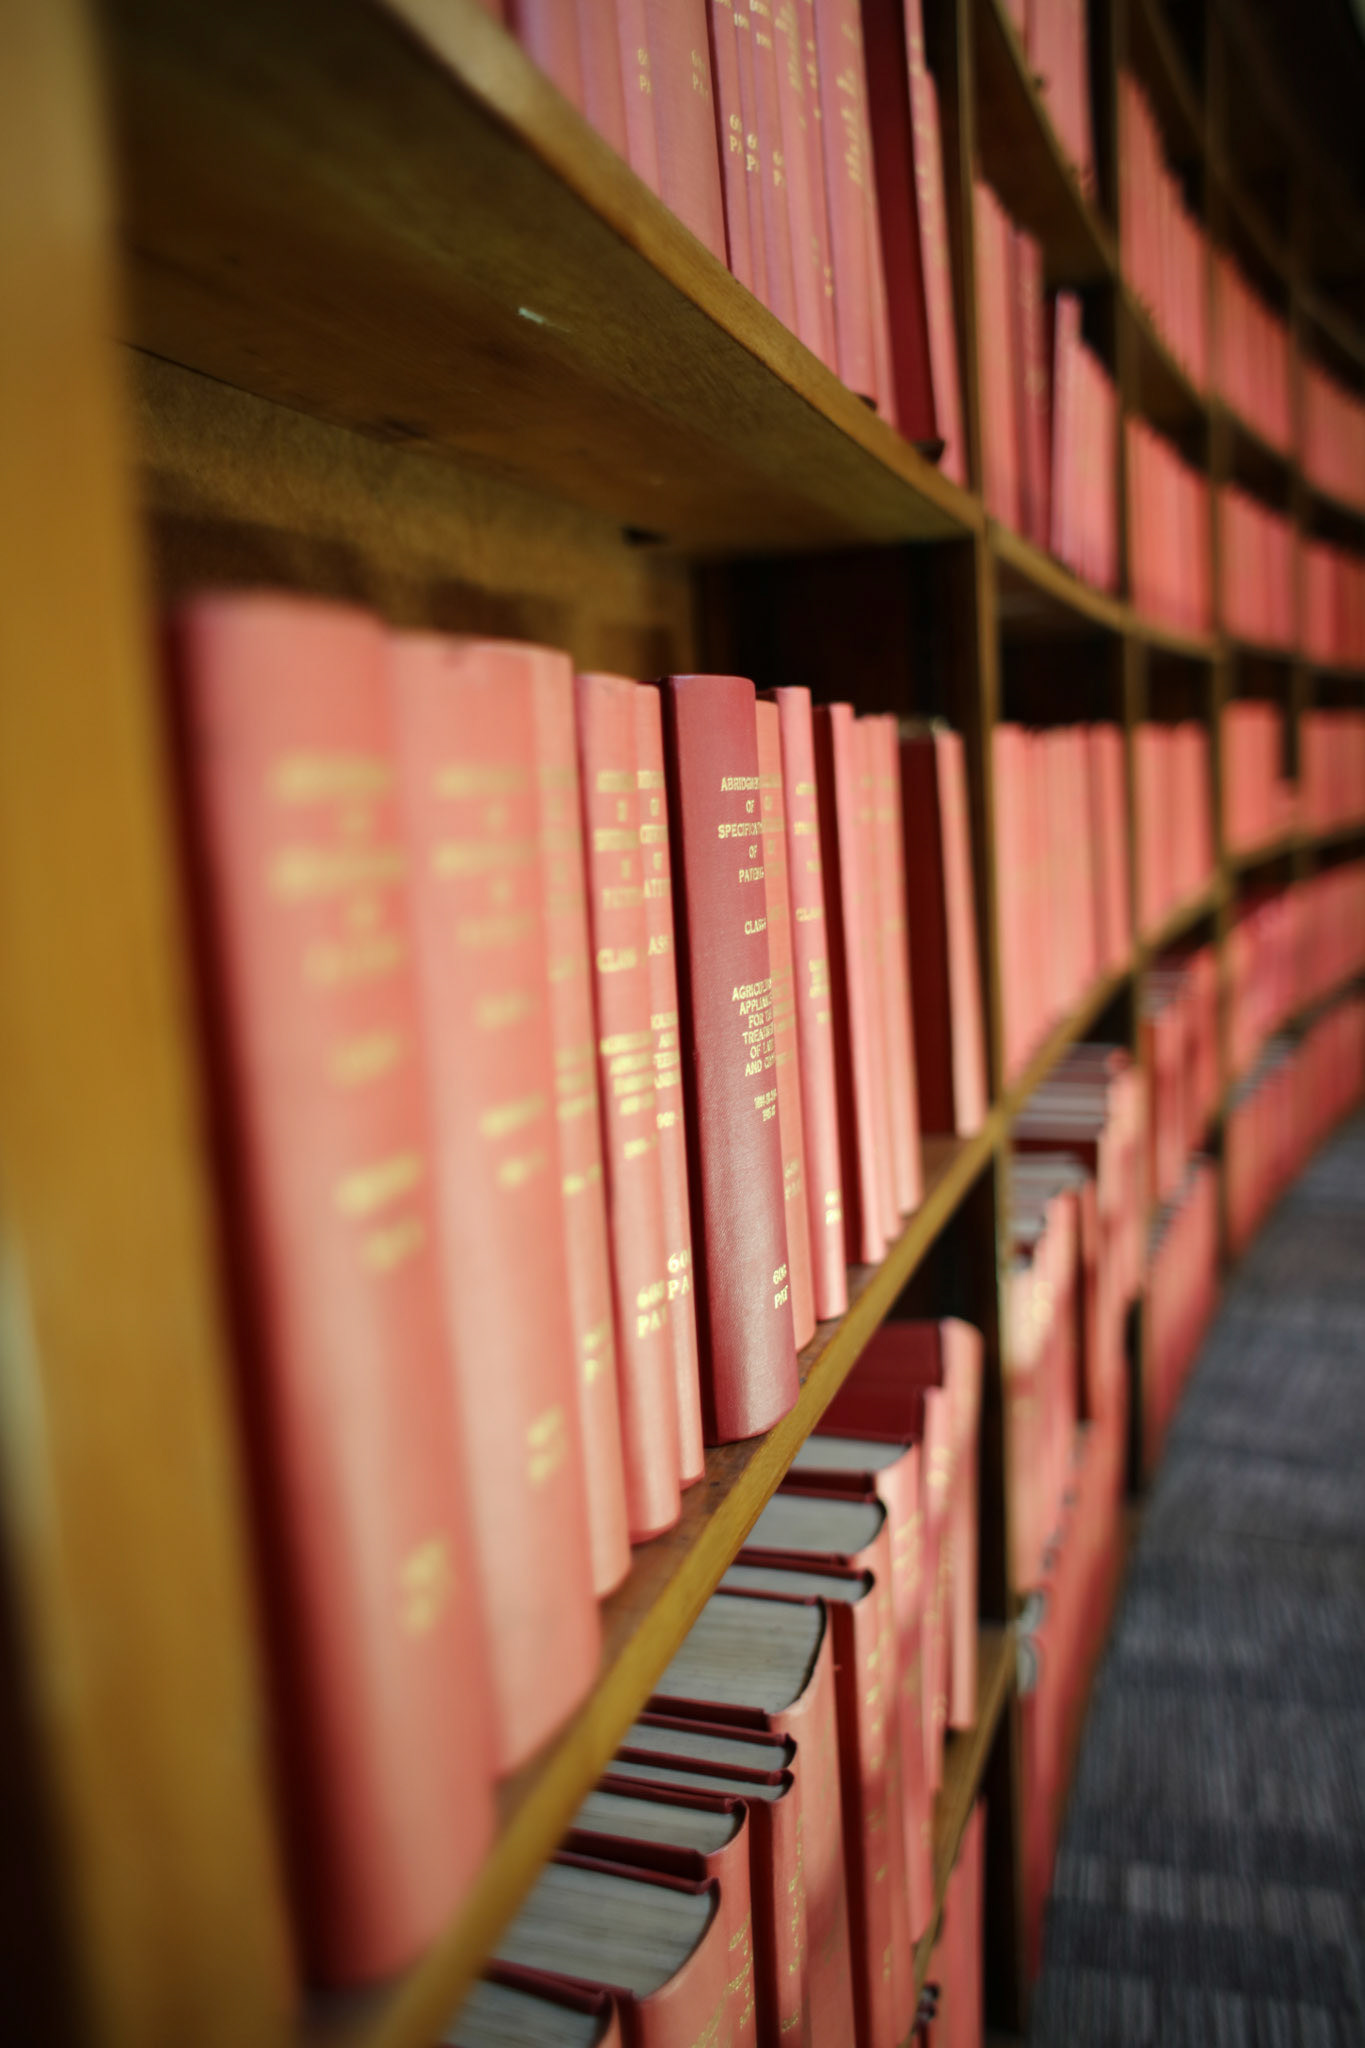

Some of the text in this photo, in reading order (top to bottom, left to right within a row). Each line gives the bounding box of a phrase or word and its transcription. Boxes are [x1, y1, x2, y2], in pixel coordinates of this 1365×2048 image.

[745, 800, 755, 814] OF
[748, 845, 758, 859] OF
[748, 1012, 764, 1029] FOR
[750, 1043, 762, 1059] OF
[745, 1059, 763, 1077] AND
[667, 1275, 690, 1300] PA
